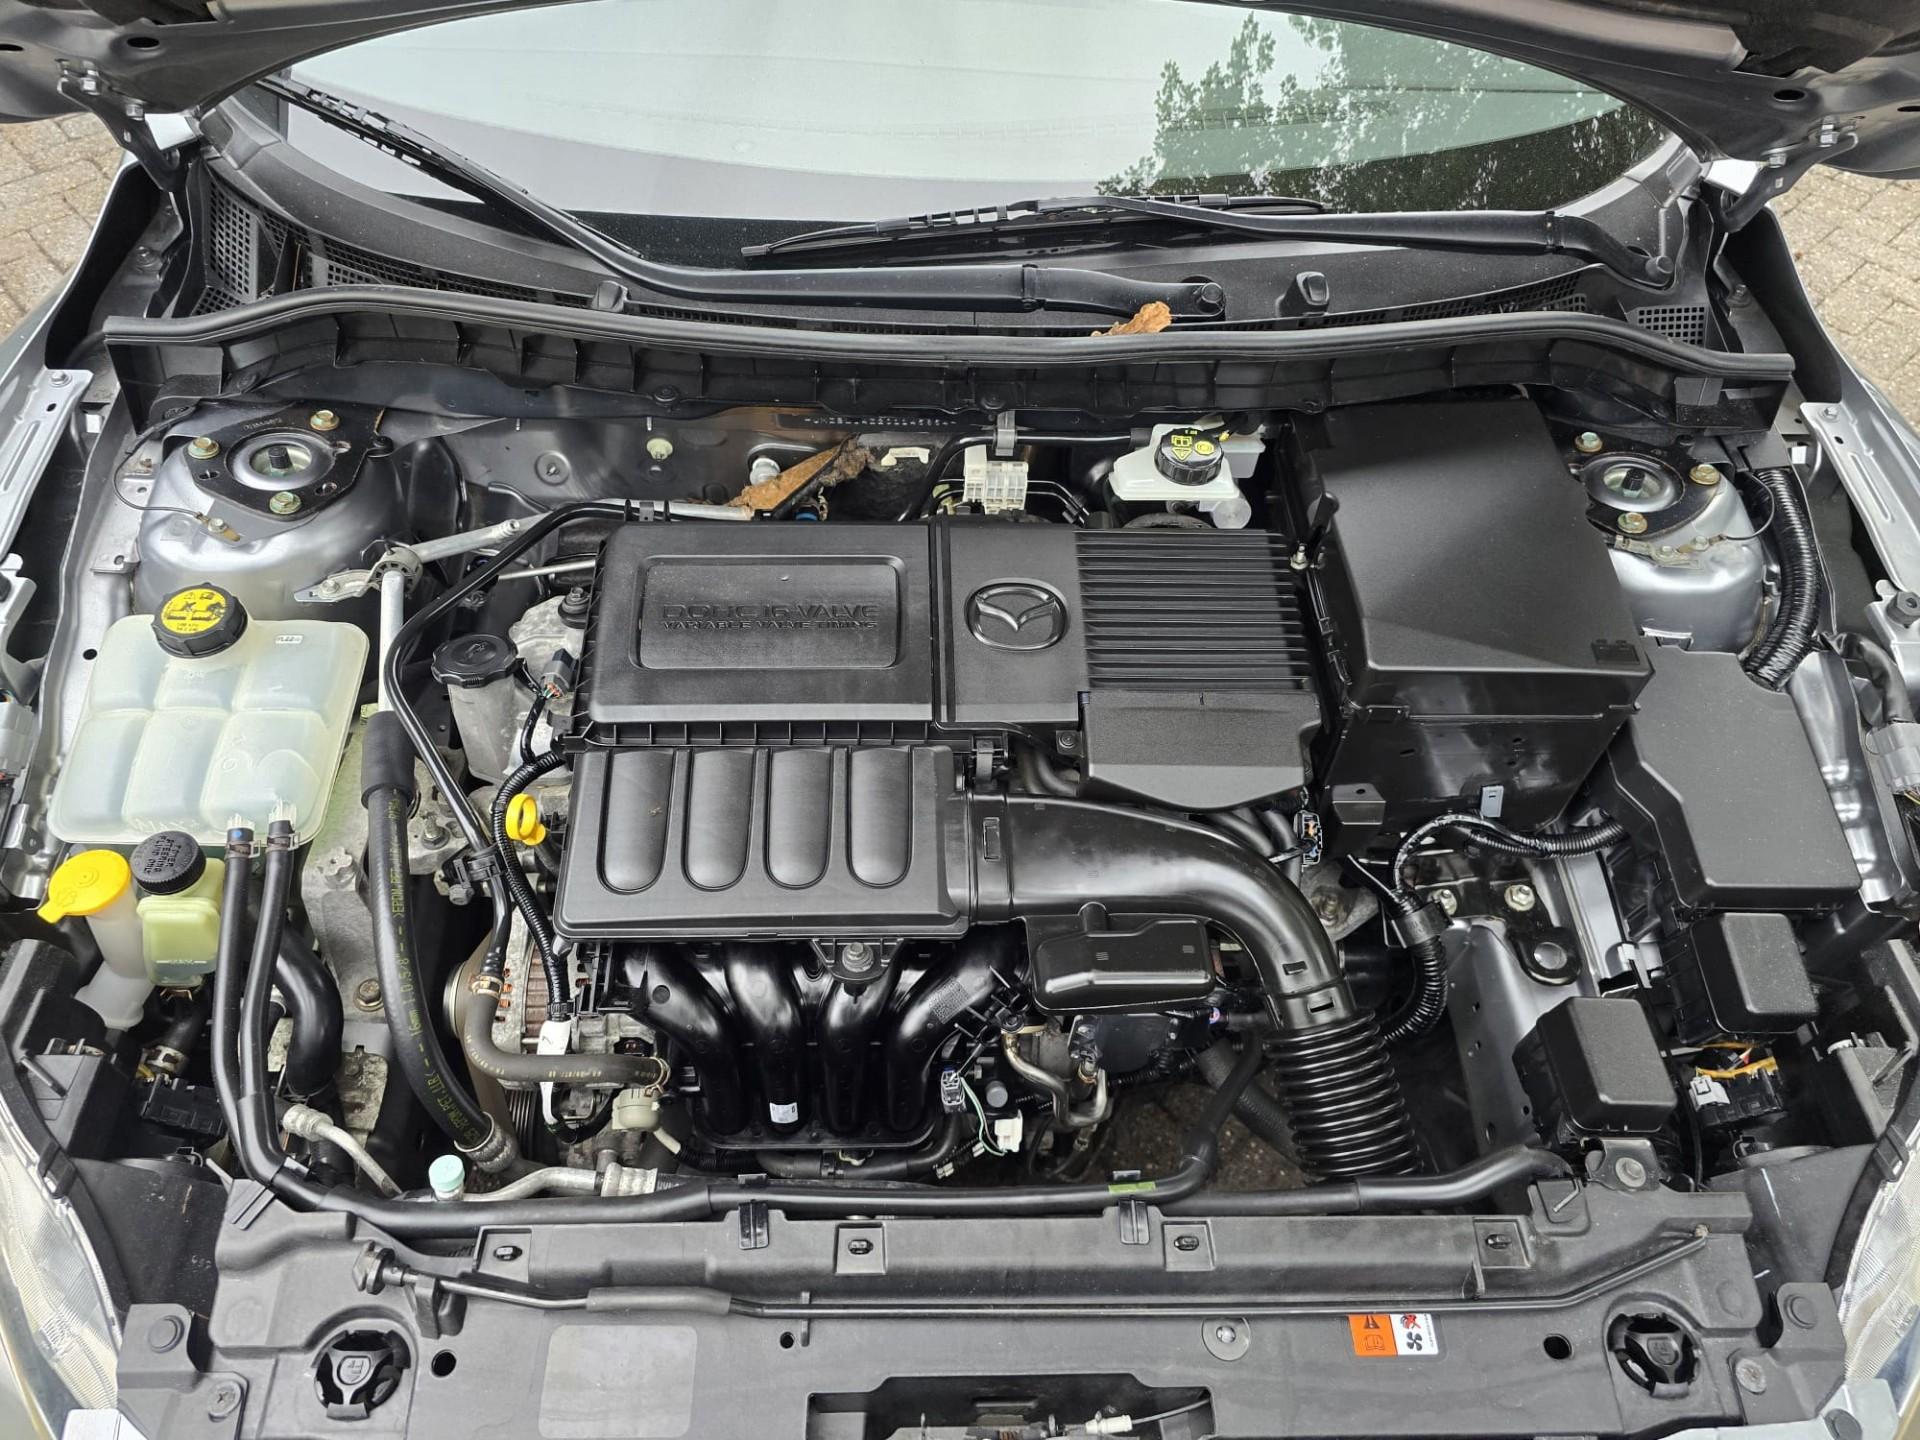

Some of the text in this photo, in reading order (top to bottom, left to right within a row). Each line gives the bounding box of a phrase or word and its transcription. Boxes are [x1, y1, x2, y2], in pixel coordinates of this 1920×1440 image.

[663, 604, 757, 619] DOHC
[798, 604, 881, 619] VALVE
[663, 620, 879, 630] VARIABLE VALVE TIMING
